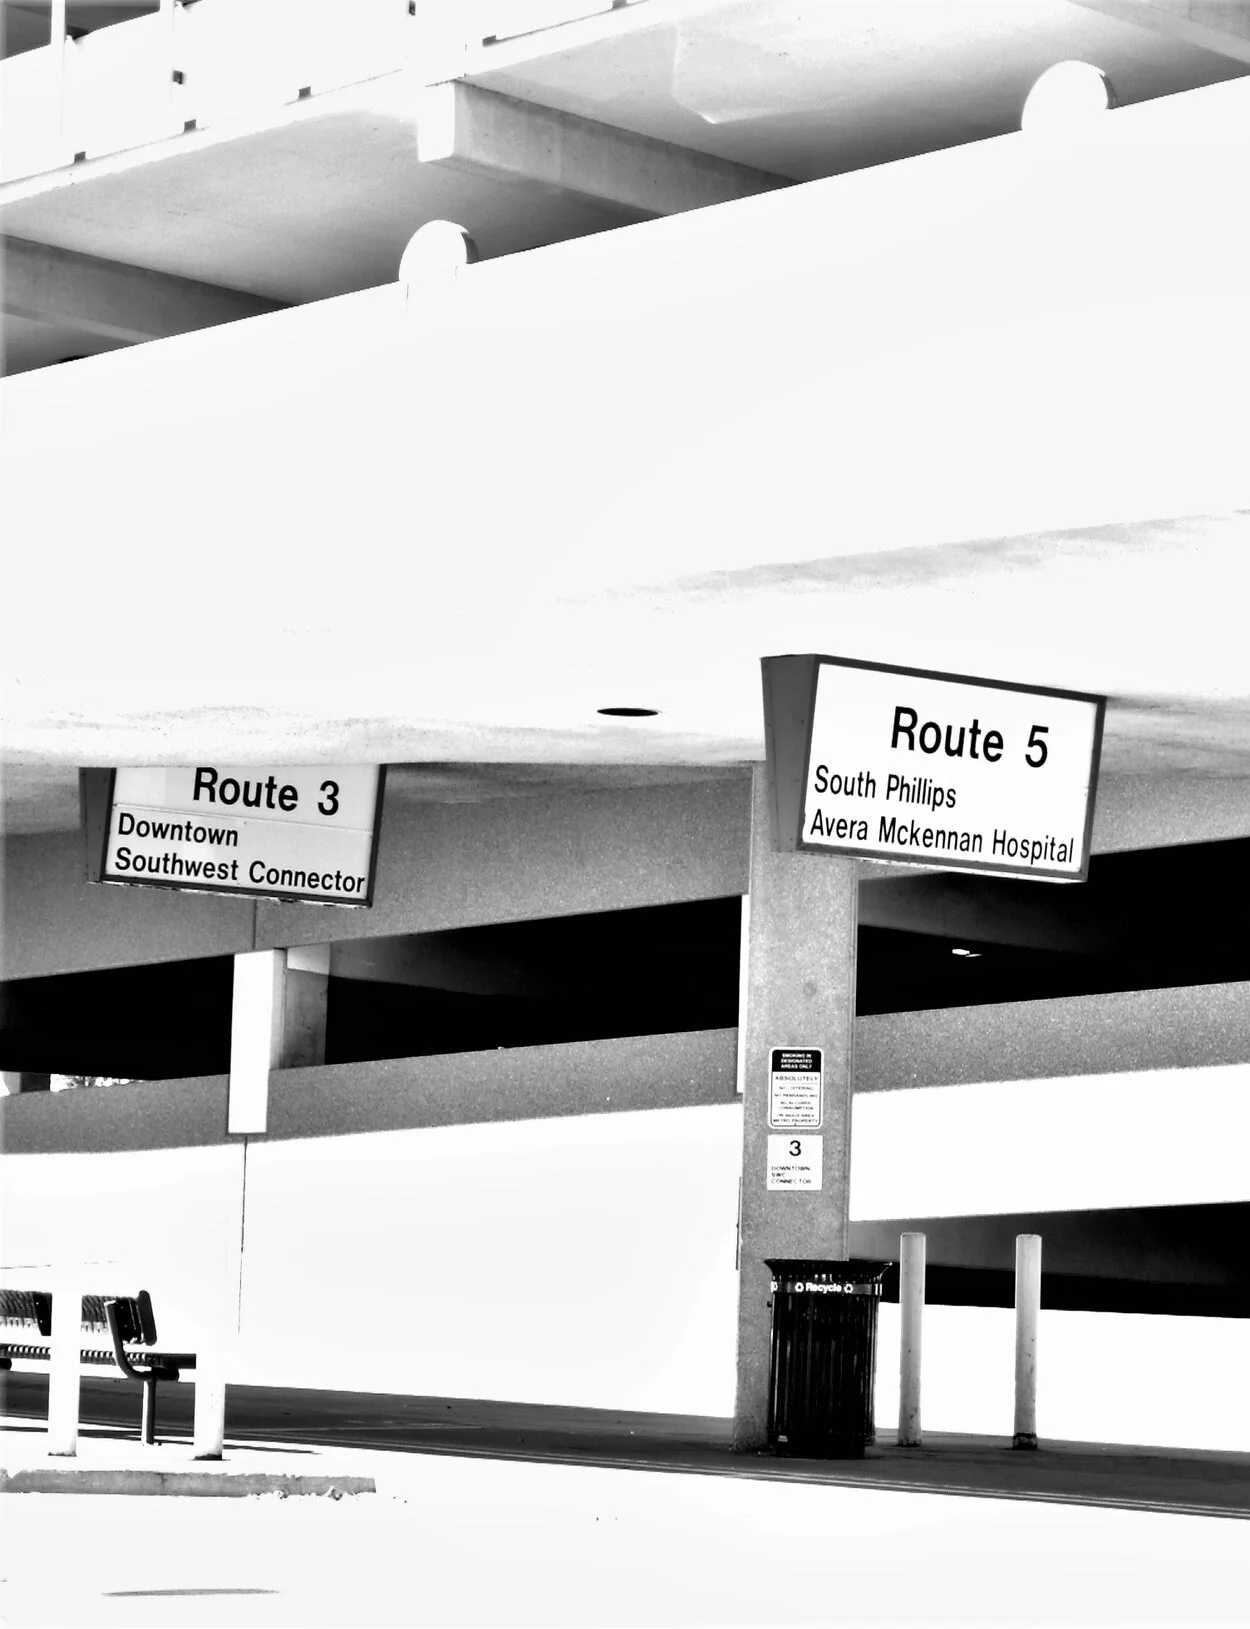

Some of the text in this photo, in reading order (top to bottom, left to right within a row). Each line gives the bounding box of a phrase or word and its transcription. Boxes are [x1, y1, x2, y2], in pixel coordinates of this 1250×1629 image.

[891, 706, 1049, 768] Route 5
[193, 767, 340, 816] Route 3
[814, 764, 957, 811] South Phillips
[118, 812, 239, 847] Downtown
[810, 809, 1074, 865] Avera Mckennan Hospital
[115, 847, 366, 893] Southwest Connector
[789, 1140, 801, 1156] 3
[805, 1282, 842, 1294] Recycle
